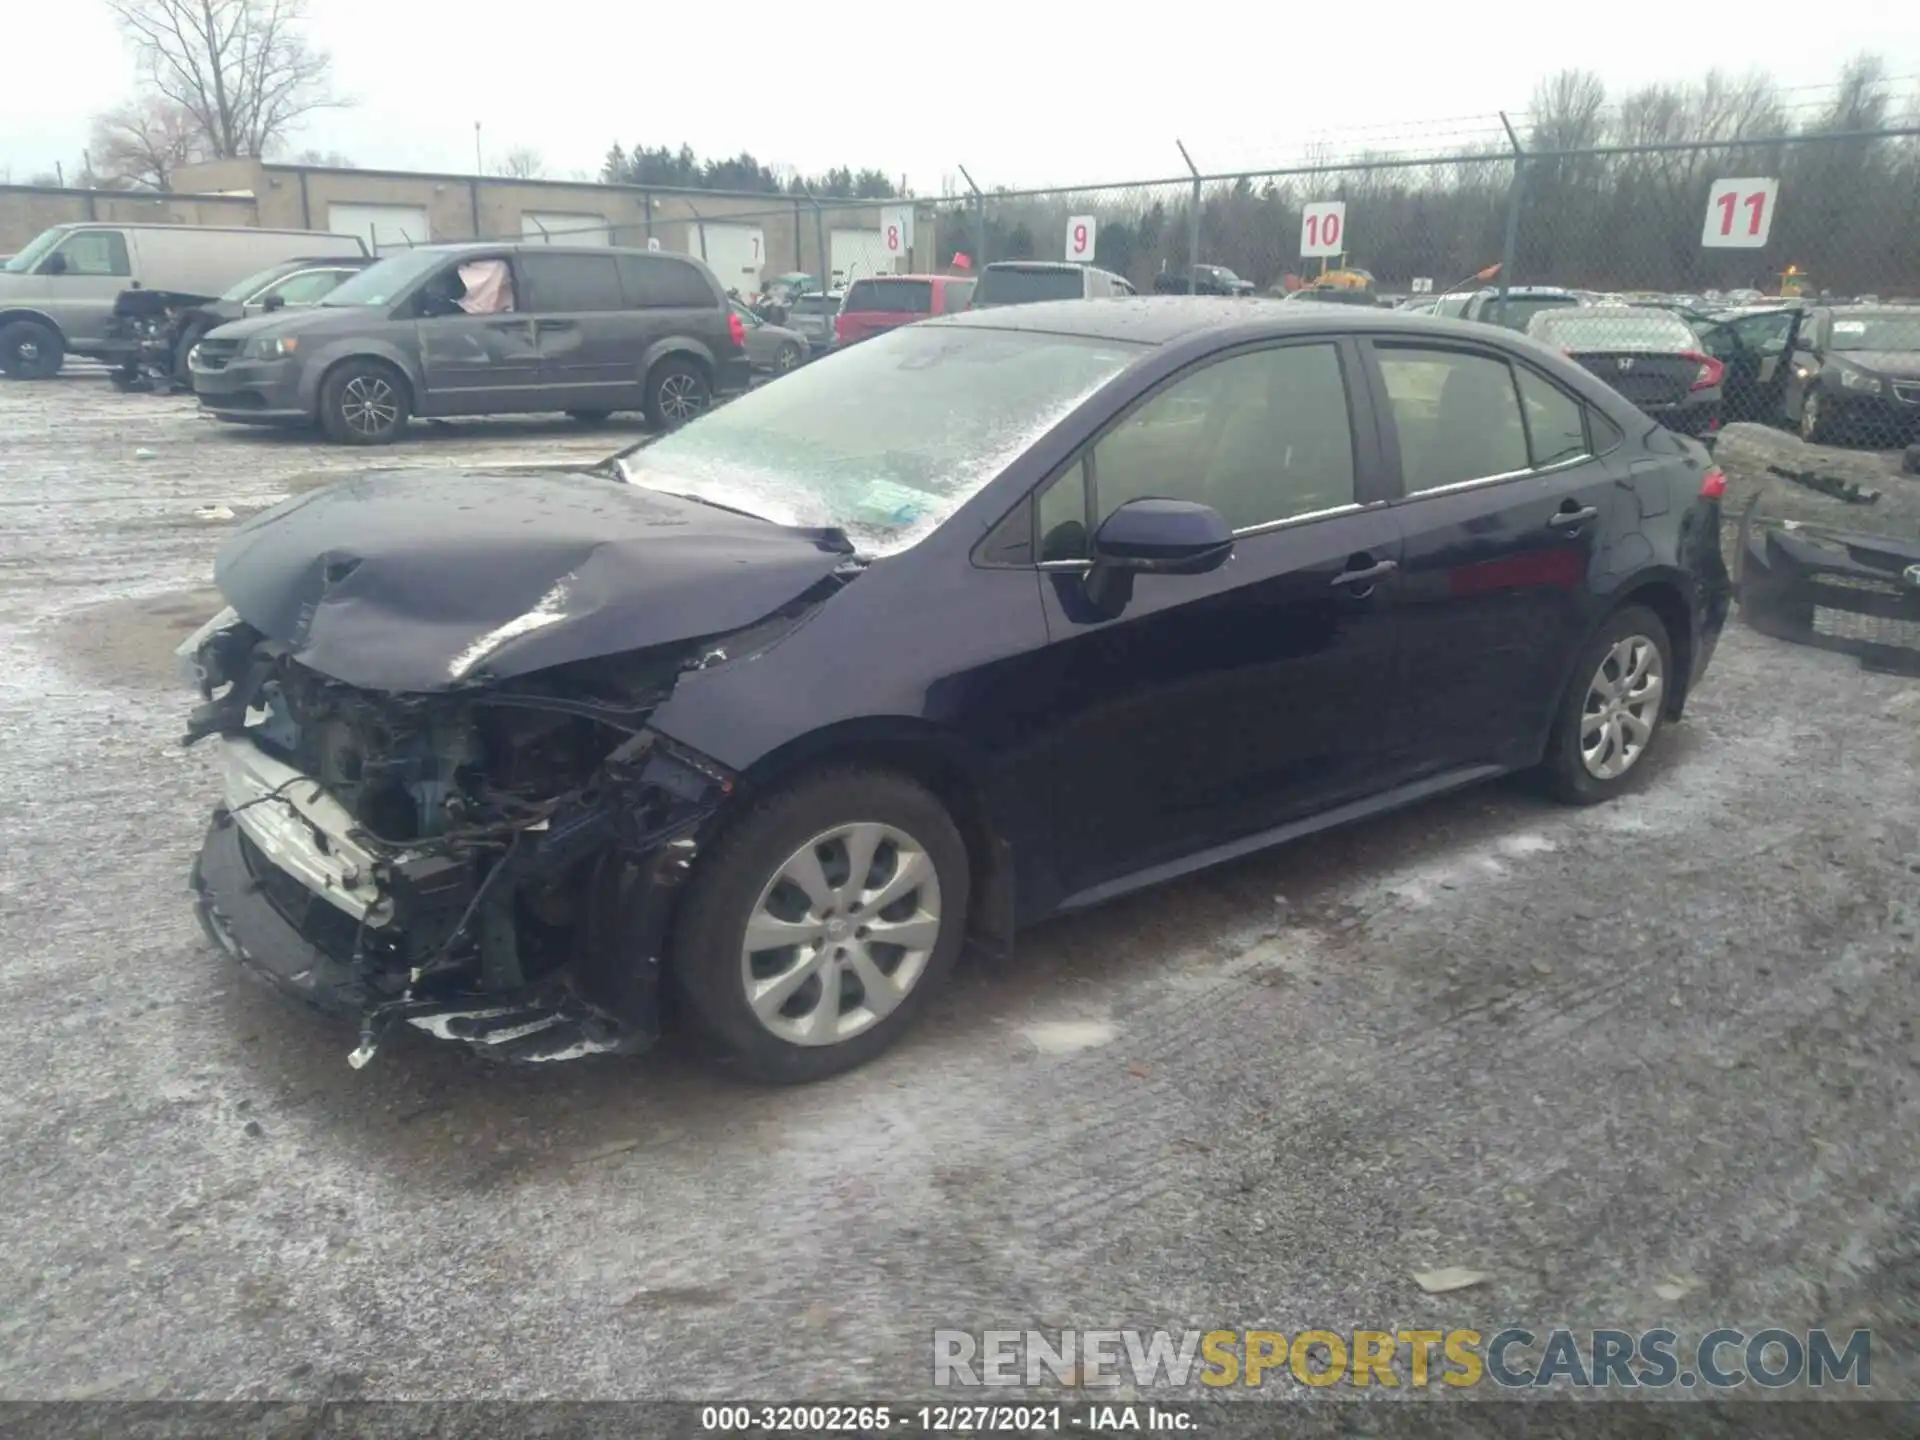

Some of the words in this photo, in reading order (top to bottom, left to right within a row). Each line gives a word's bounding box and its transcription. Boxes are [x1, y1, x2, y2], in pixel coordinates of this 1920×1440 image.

[1717, 191, 1766, 235] 11
[887, 225, 898, 250] 8
[1074, 224, 1086, 254] 9
[1306, 213, 1339, 247] 10
